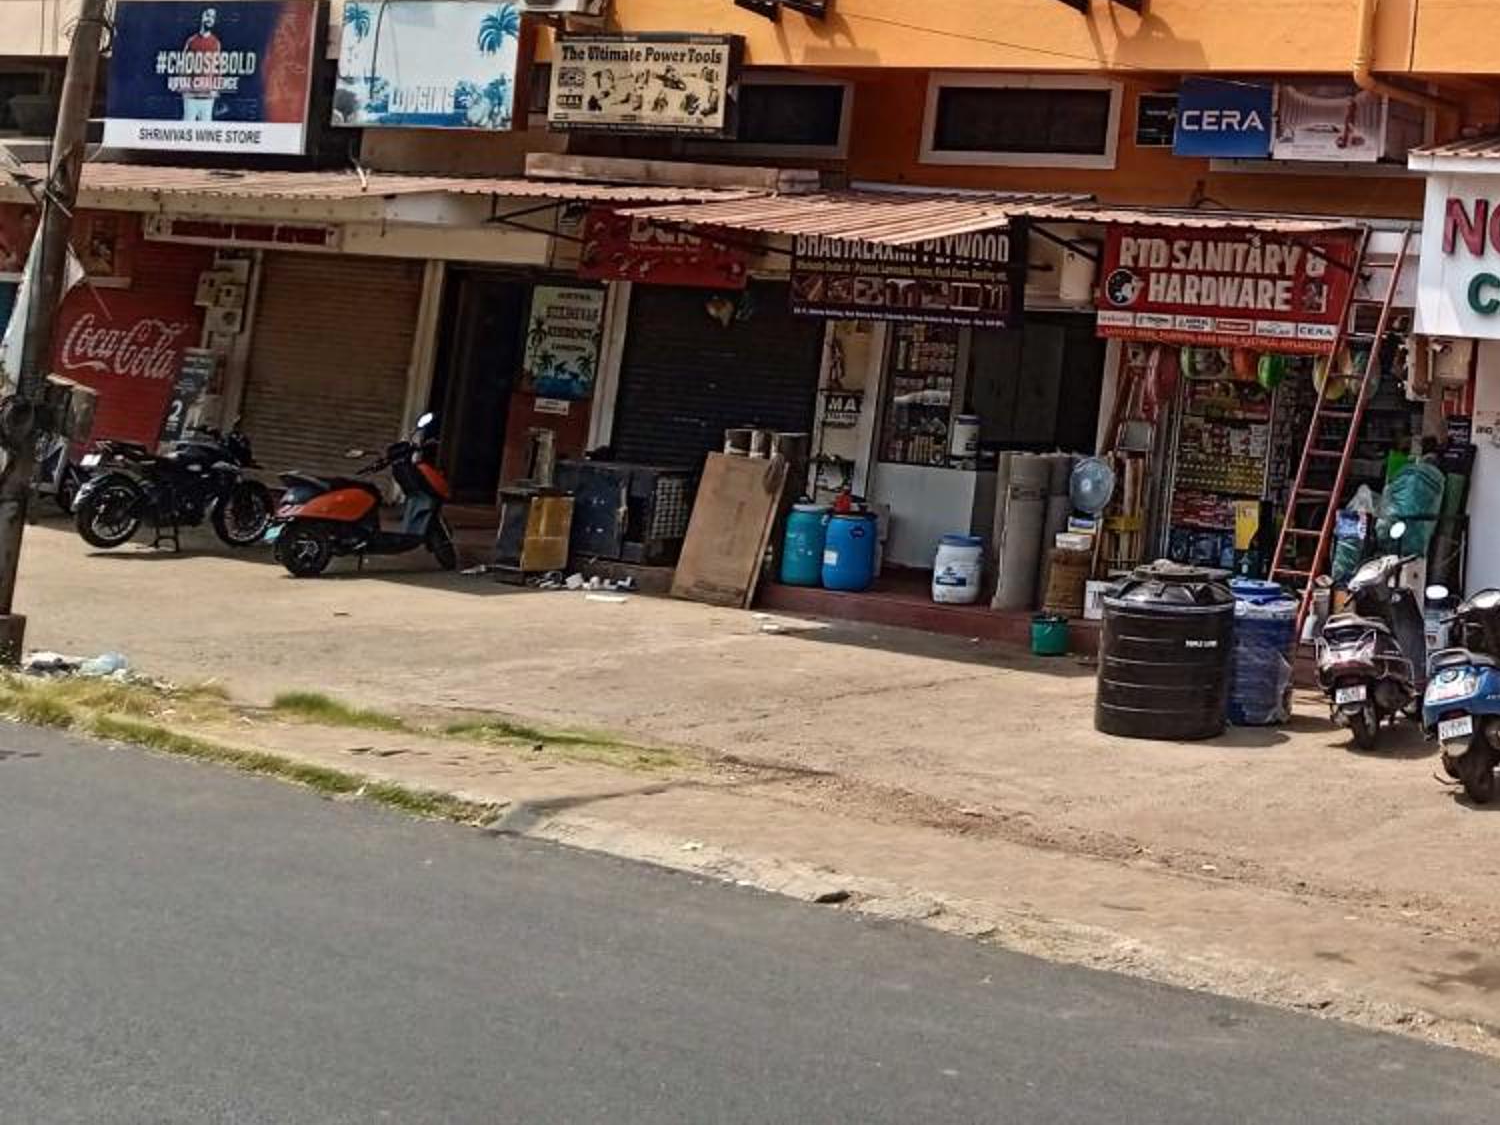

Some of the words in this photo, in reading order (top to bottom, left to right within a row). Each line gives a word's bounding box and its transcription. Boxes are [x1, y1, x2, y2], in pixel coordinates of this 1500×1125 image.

[156, 50, 256, 74] #CHOOSEBOLD
[562, 45, 585, 61] The
[588, 46, 641, 62] Ultimate
[1181, 109, 1264, 131] CERA
[138, 128, 193, 143] SHRINIVAS
[195, 130, 223, 144] WINE
[225, 131, 262, 145] STORE
[1171, 239, 1302, 275] SANITARY
[1148, 272, 1294, 311] HARDWARE
[1299, 326, 1333, 336] CERA
